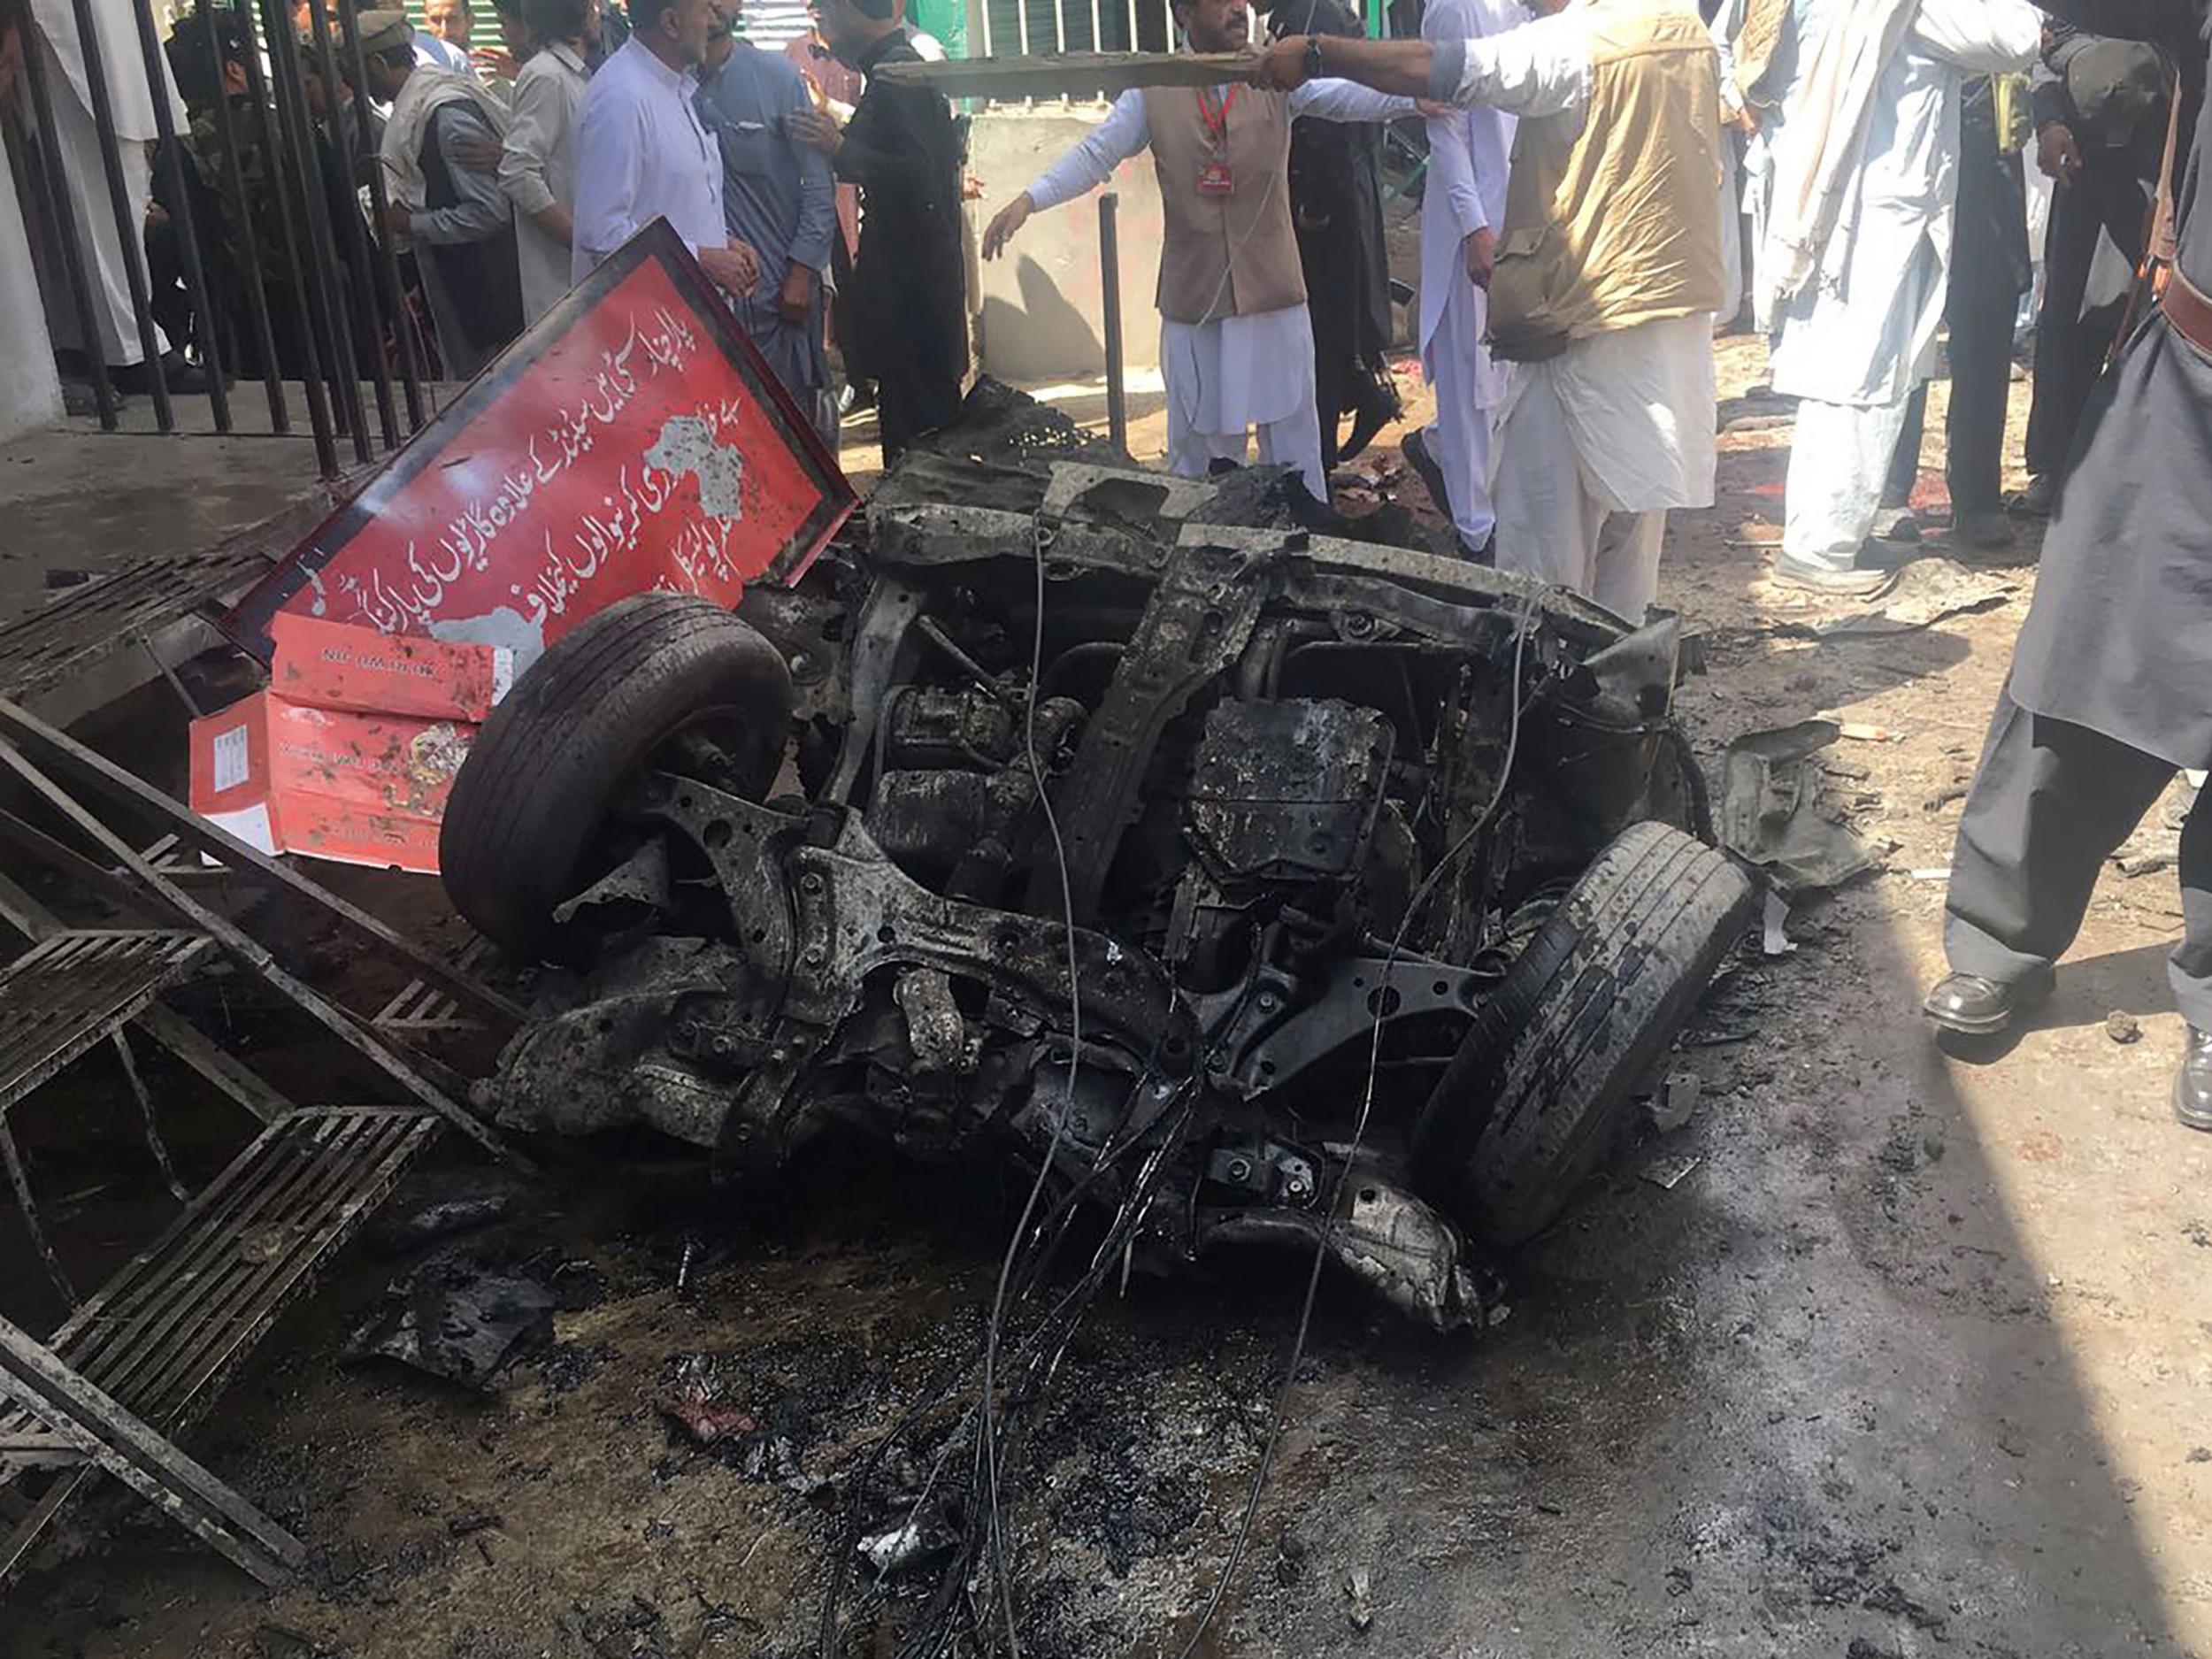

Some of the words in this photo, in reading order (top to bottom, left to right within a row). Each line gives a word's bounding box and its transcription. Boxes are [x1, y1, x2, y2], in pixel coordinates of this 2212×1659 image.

[590, 371, 625, 423] میں
[529, 433, 562, 482] کے
[409, 540, 442, 608] کی
